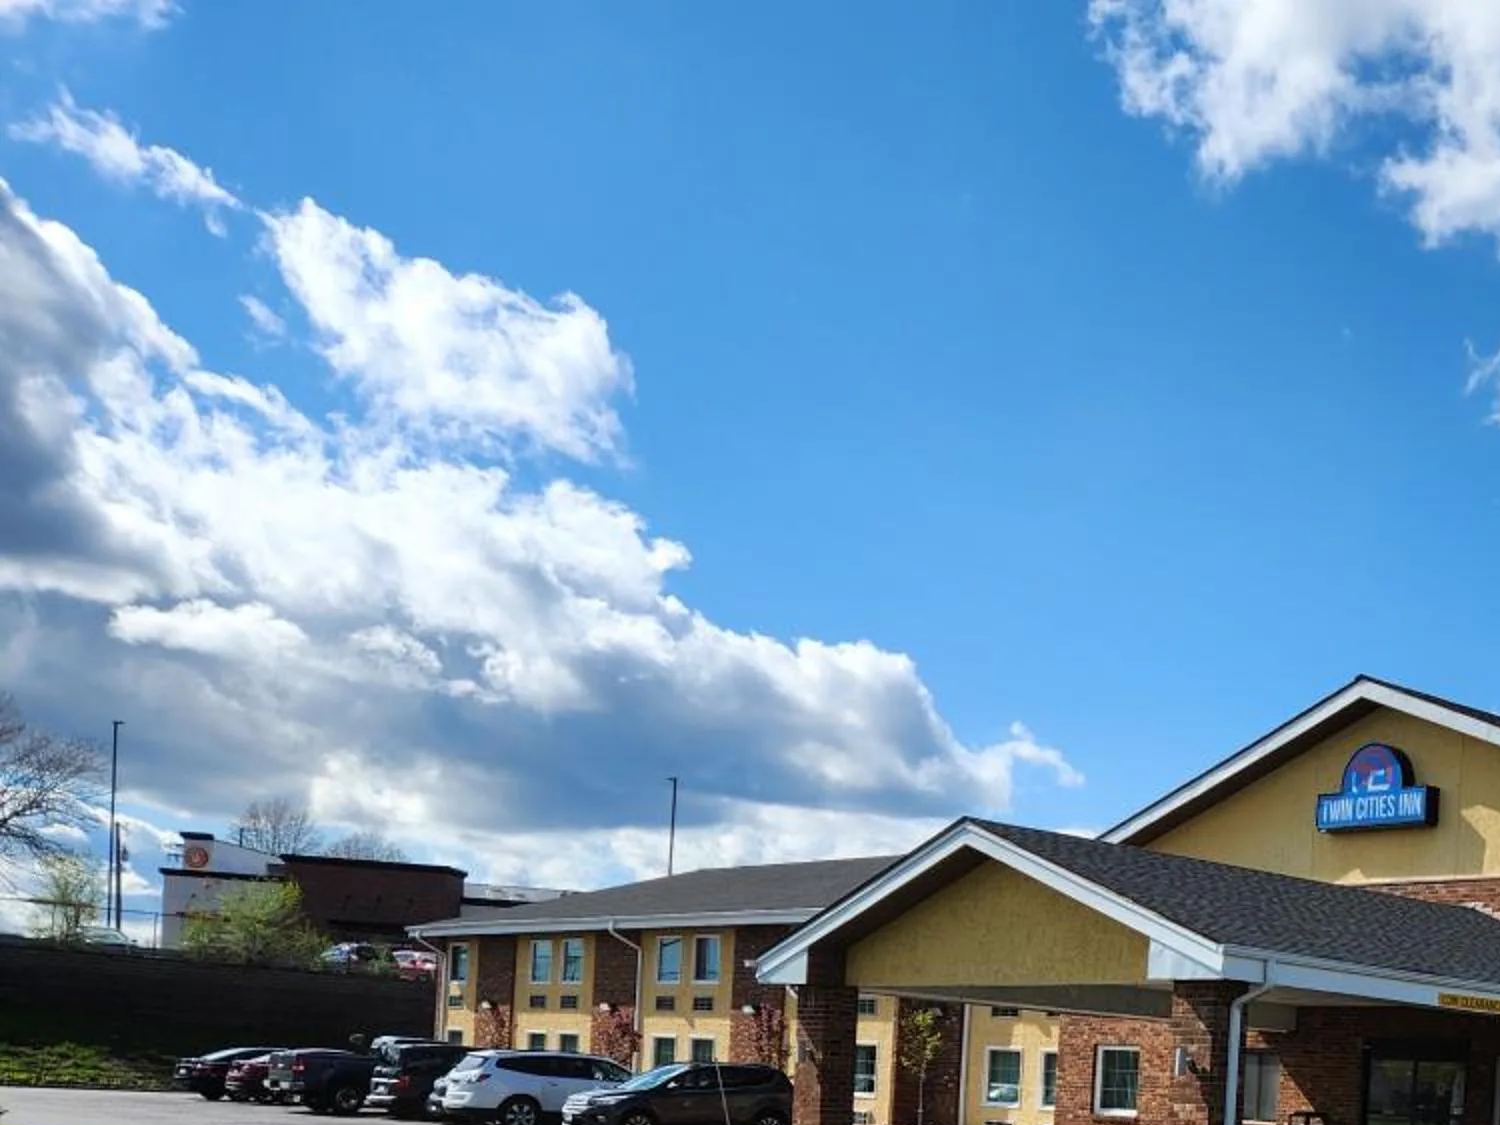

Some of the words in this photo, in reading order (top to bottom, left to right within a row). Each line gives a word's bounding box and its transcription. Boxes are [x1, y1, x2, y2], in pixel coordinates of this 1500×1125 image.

[1322, 797, 1353, 823] TWIN
[1355, 795, 1395, 819] CITIES
[1398, 791, 1422, 816] INN
